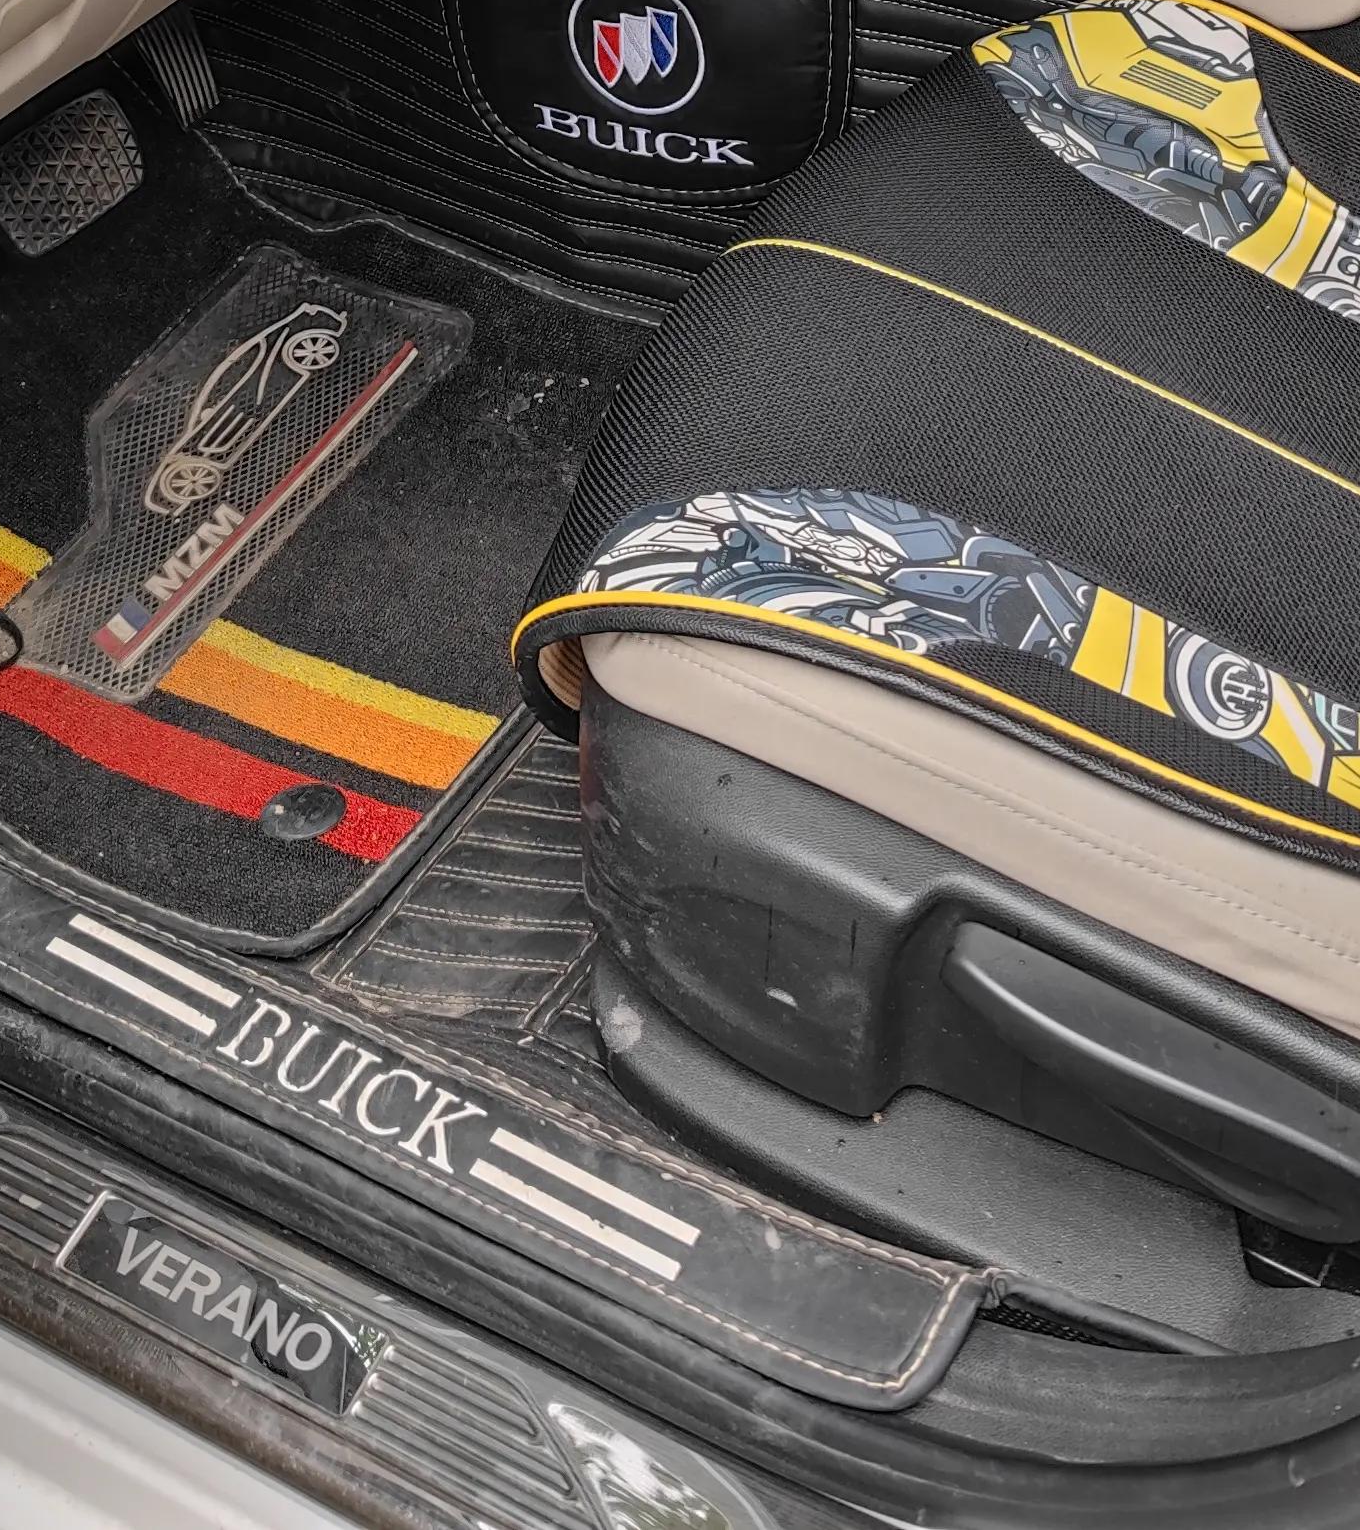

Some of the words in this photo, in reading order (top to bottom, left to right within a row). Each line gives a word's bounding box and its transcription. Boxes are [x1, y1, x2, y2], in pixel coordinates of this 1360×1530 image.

[533, 103, 754, 166] BUICK
[144, 503, 245, 601] MZM
[216, 998, 488, 1174] BUICK
[114, 1227, 333, 1371] VERANO
